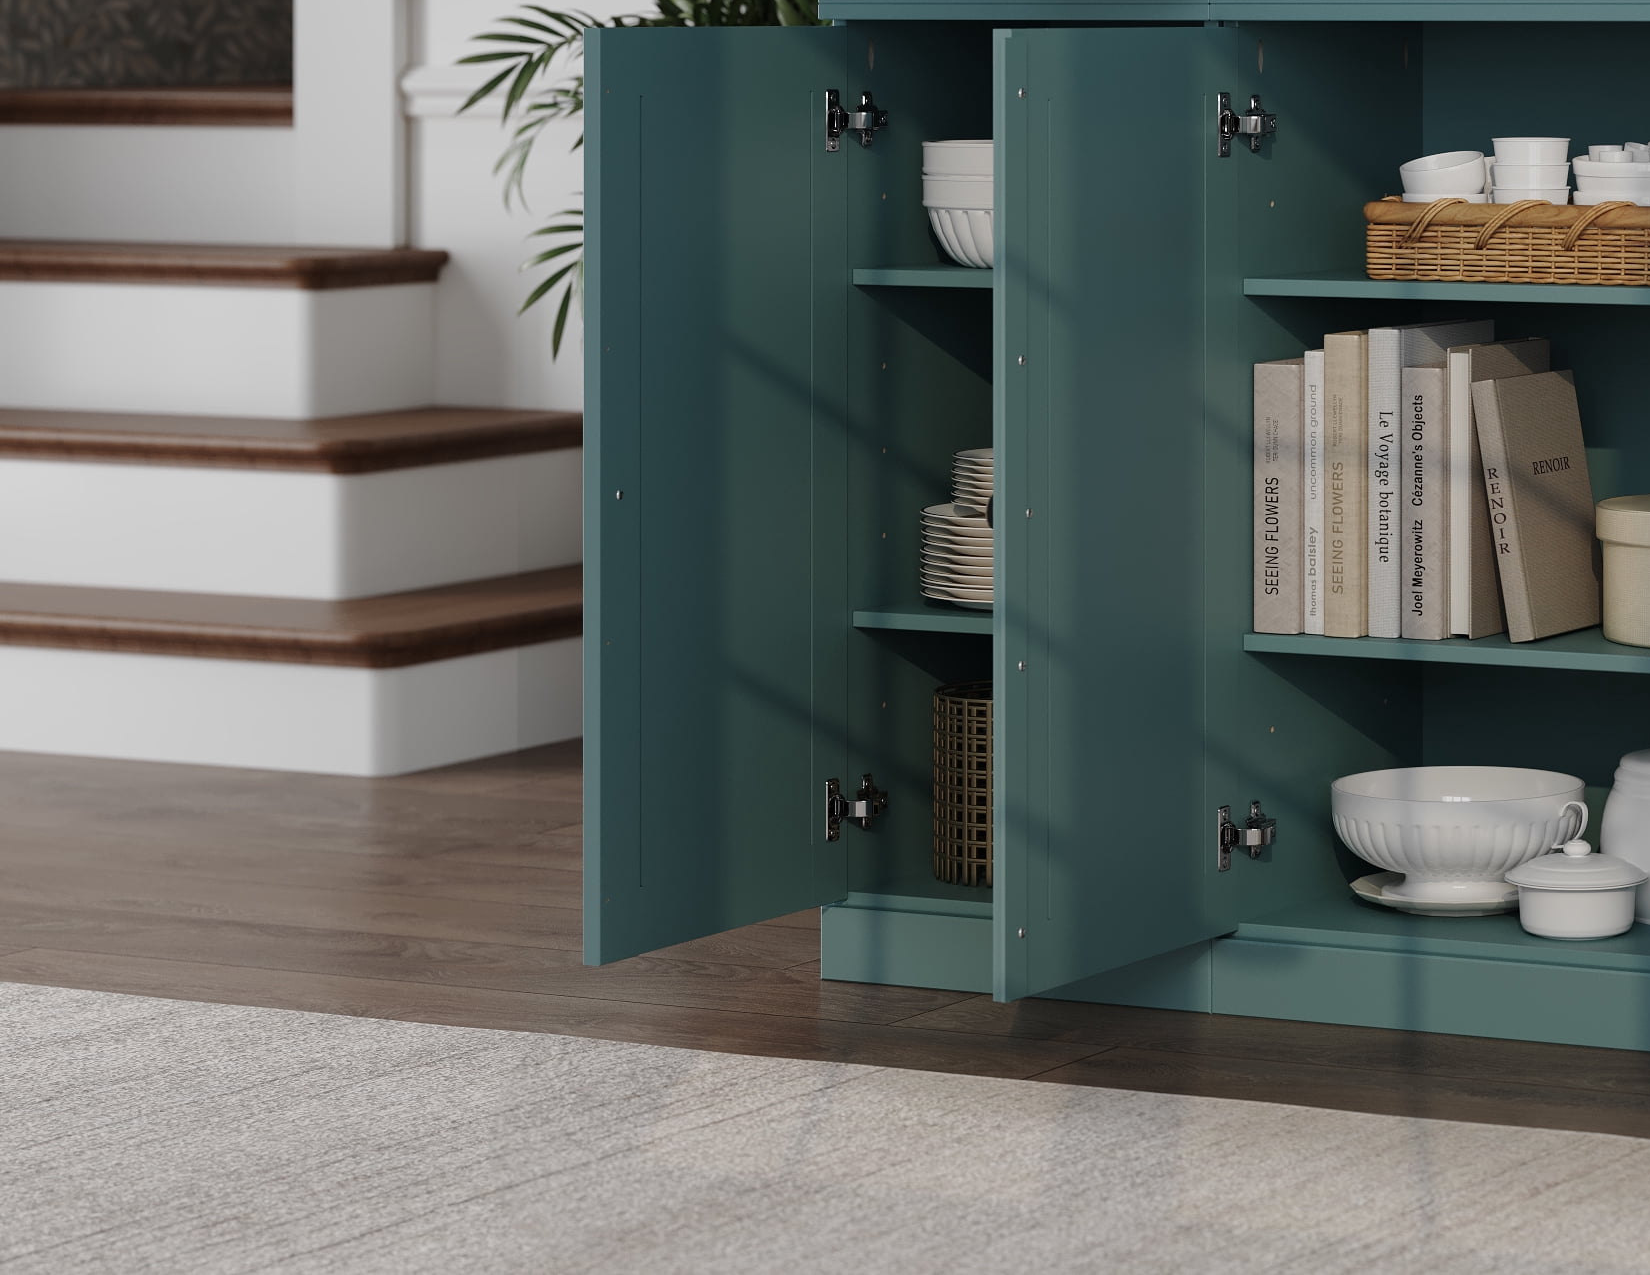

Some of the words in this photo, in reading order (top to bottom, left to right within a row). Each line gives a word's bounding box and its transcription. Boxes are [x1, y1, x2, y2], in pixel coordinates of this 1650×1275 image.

[1308, 384, 1319, 428] ground
[1378, 411, 1394, 428] Le
[1411, 394, 1426, 442] Objects
[1374, 433, 1394, 486] Voyage
[1411, 444, 1424, 507] Cézanne's
[1532, 456, 1571, 476] RENOIR
[1264, 477, 1279, 542] FLOWERS
[1331, 461, 1344, 532] FLOWERS
[1487, 467, 1511, 555] RENOIR
[1307, 526, 1319, 577] balsley
[1374, 491, 1394, 563] botanique
[1264, 546, 1279, 596] SEEING
[1331, 539, 1344, 595] SEEING
[1411, 519, 1426, 588] Meyerowitz
[1309, 580, 1317, 617] thomas
[1411, 590, 1424, 617] Joel
